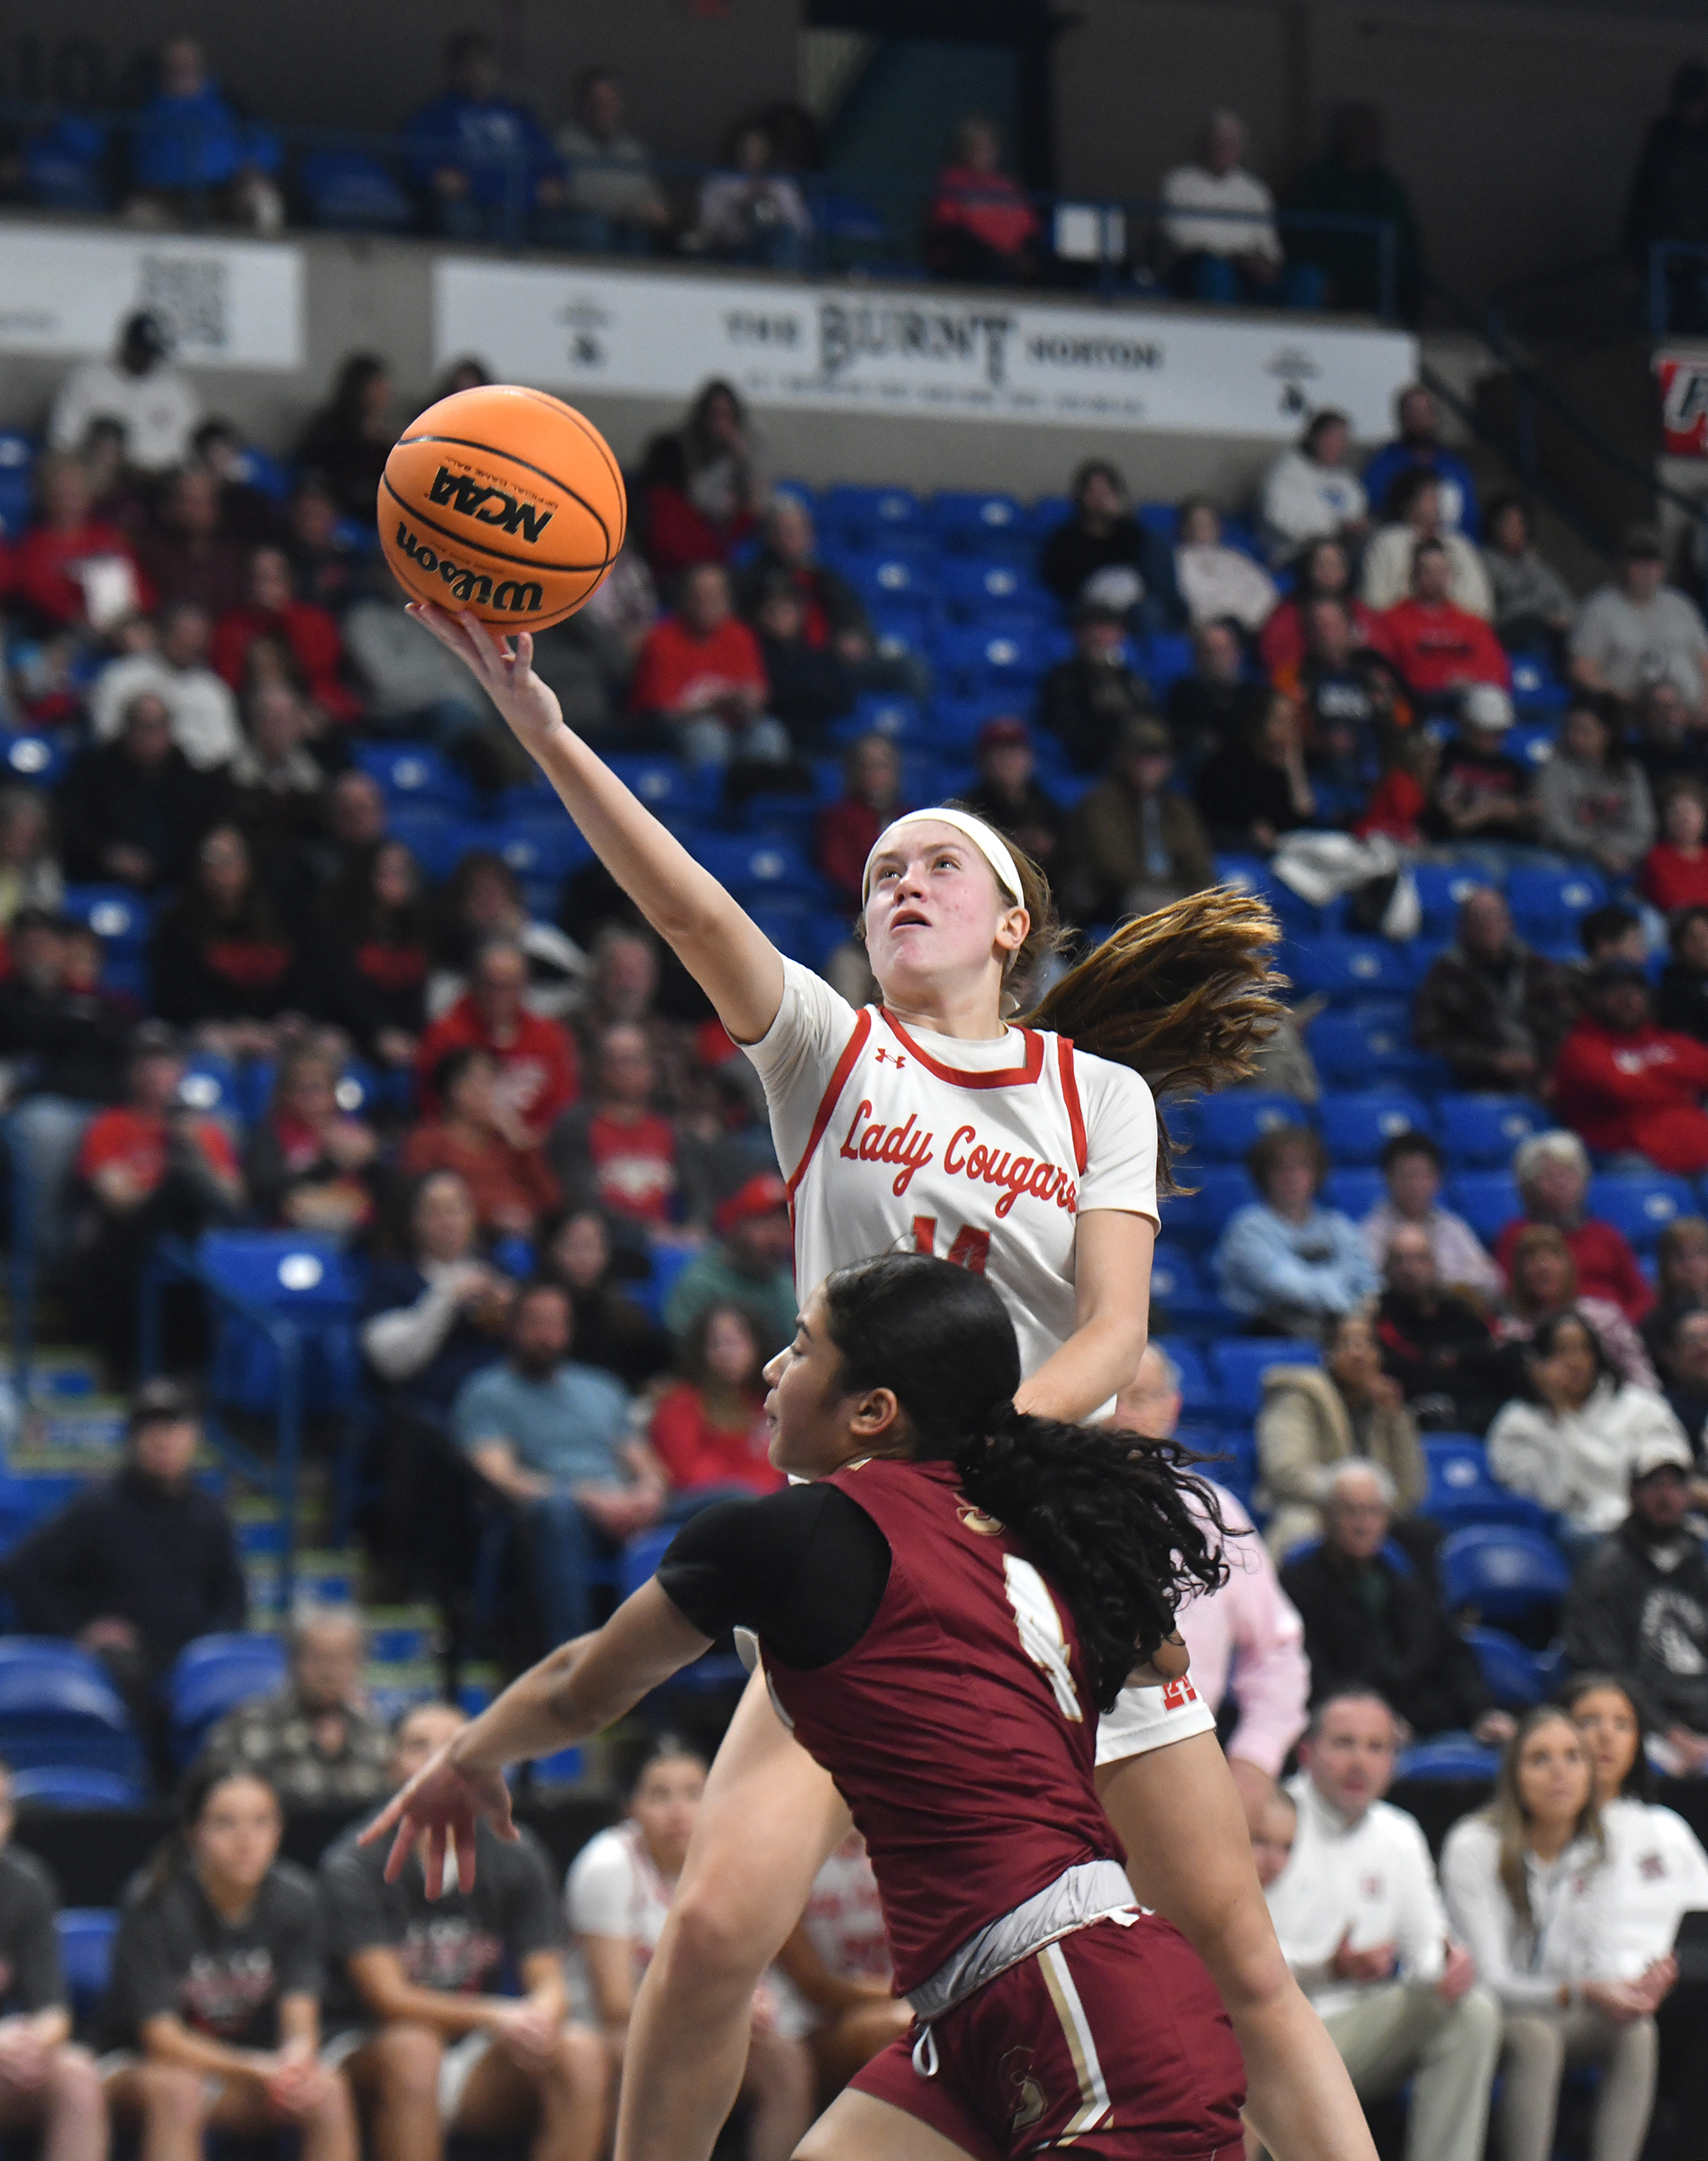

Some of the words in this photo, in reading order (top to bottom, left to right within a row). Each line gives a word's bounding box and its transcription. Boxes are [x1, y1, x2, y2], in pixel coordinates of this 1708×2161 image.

[818, 302, 1018, 385] BURNT
[429, 466, 555, 545] NCAA
[396, 521, 545, 612] Wilson
[840, 1099, 934, 1198] Lady
[944, 1125, 1077, 1218] Cougars
